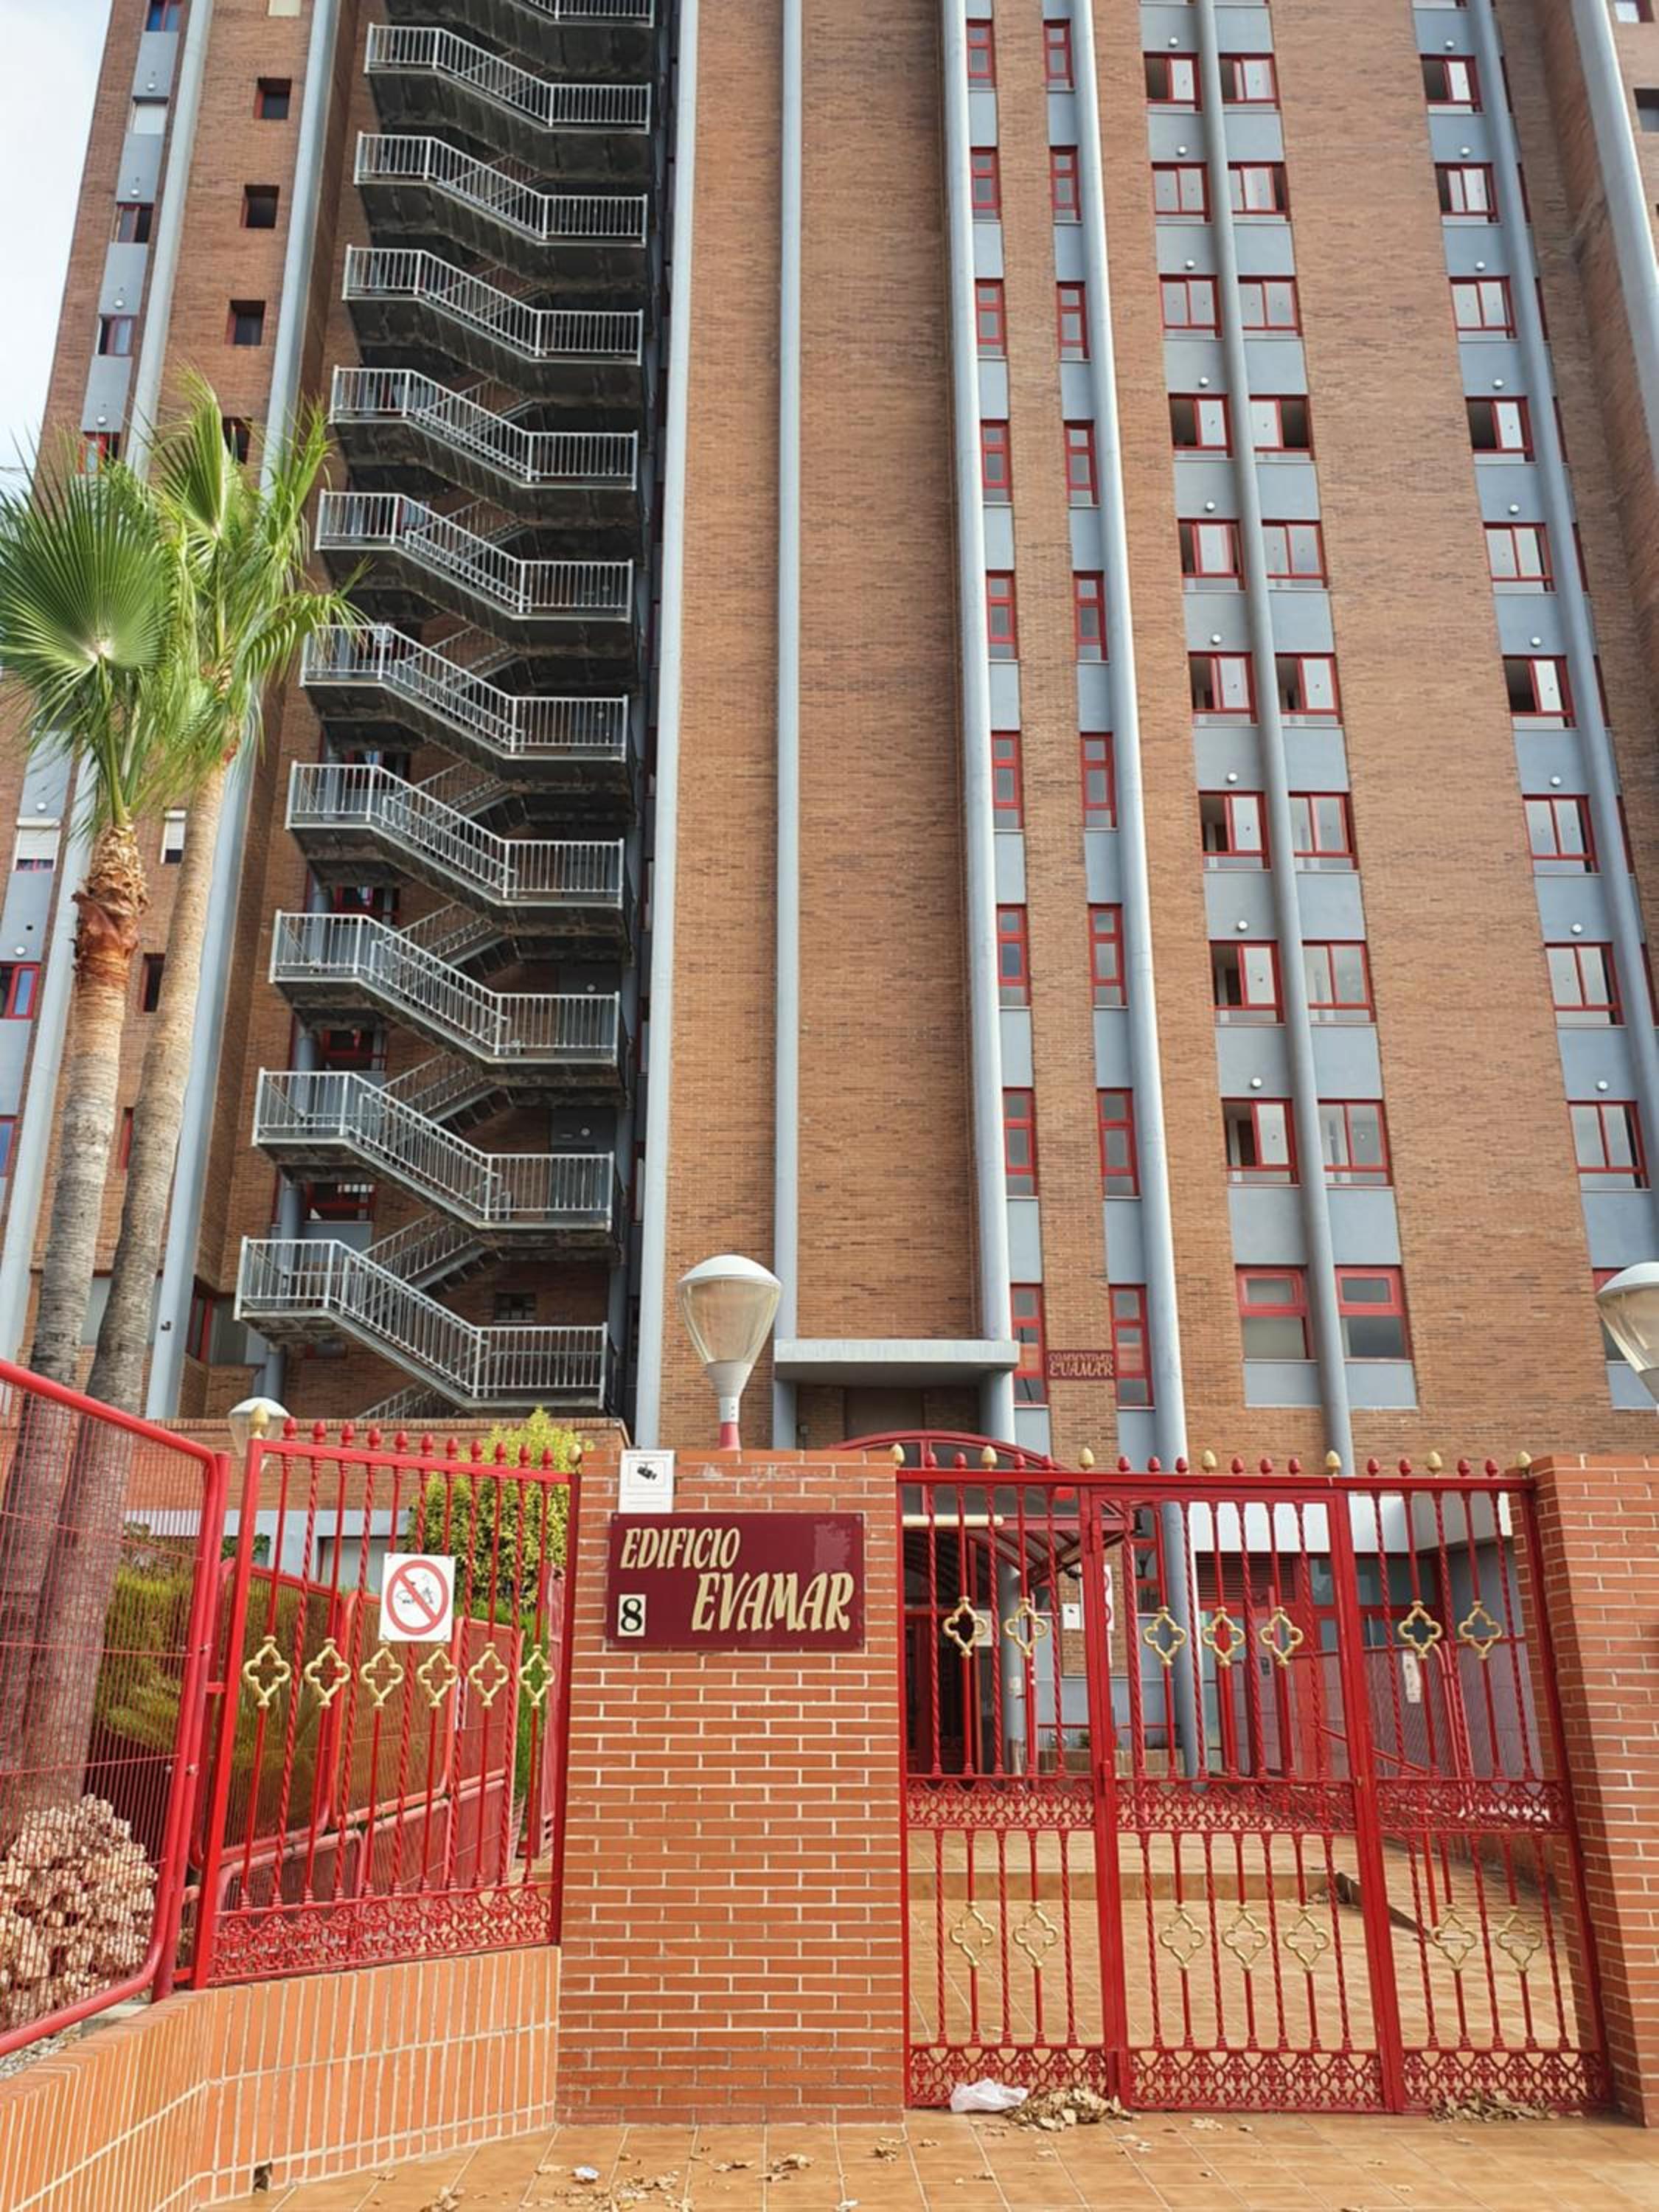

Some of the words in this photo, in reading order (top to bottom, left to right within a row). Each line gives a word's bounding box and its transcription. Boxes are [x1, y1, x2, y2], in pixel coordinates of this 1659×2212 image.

[620, 1528, 740, 1568] EDIFICIO
[620, 1598, 643, 1632] 8
[692, 1573, 854, 1632] EVAMAR
